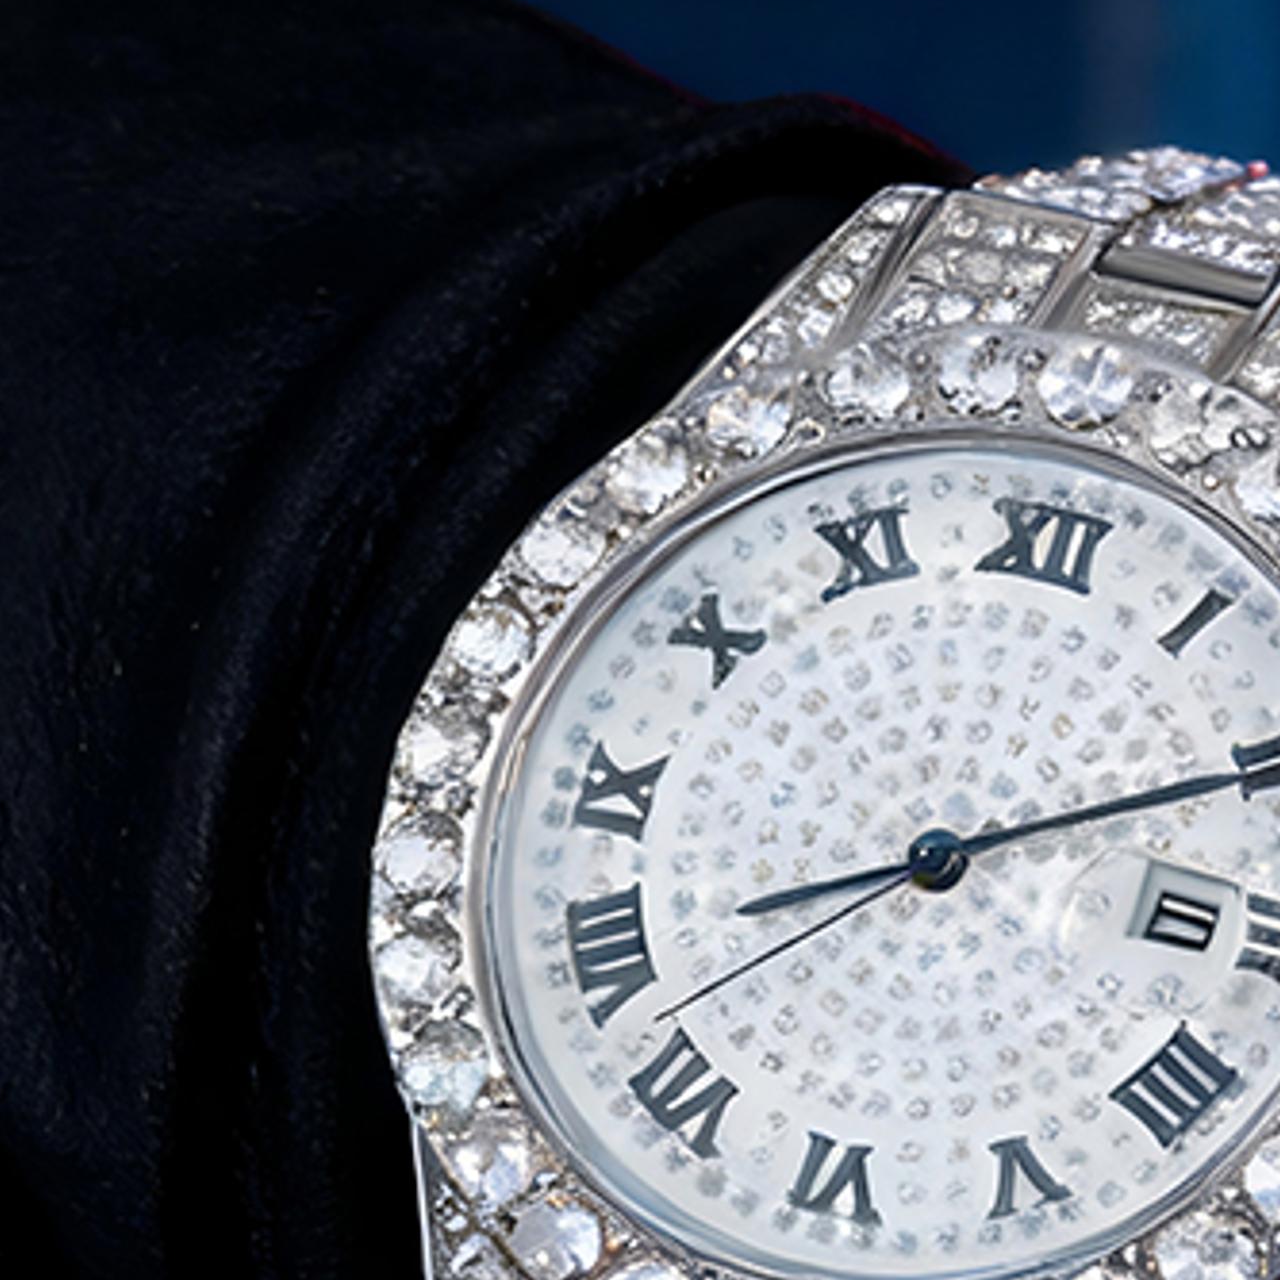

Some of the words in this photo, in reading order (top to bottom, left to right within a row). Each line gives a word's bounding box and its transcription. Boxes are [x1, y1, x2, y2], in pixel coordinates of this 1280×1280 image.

[814, 506, 920, 602] XI
[974, 498, 1115, 595] XII
[667, 593, 768, 690] X
[1156, 588, 1234, 660] I
[571, 740, 671, 843] IX
[566, 881, 658, 1030] VIII
[628, 1026, 740, 1160] VII
[1109, 1020, 1238, 1149] IIII
[786, 1130, 883, 1226] VI
[987, 1134, 1073, 1221] V
